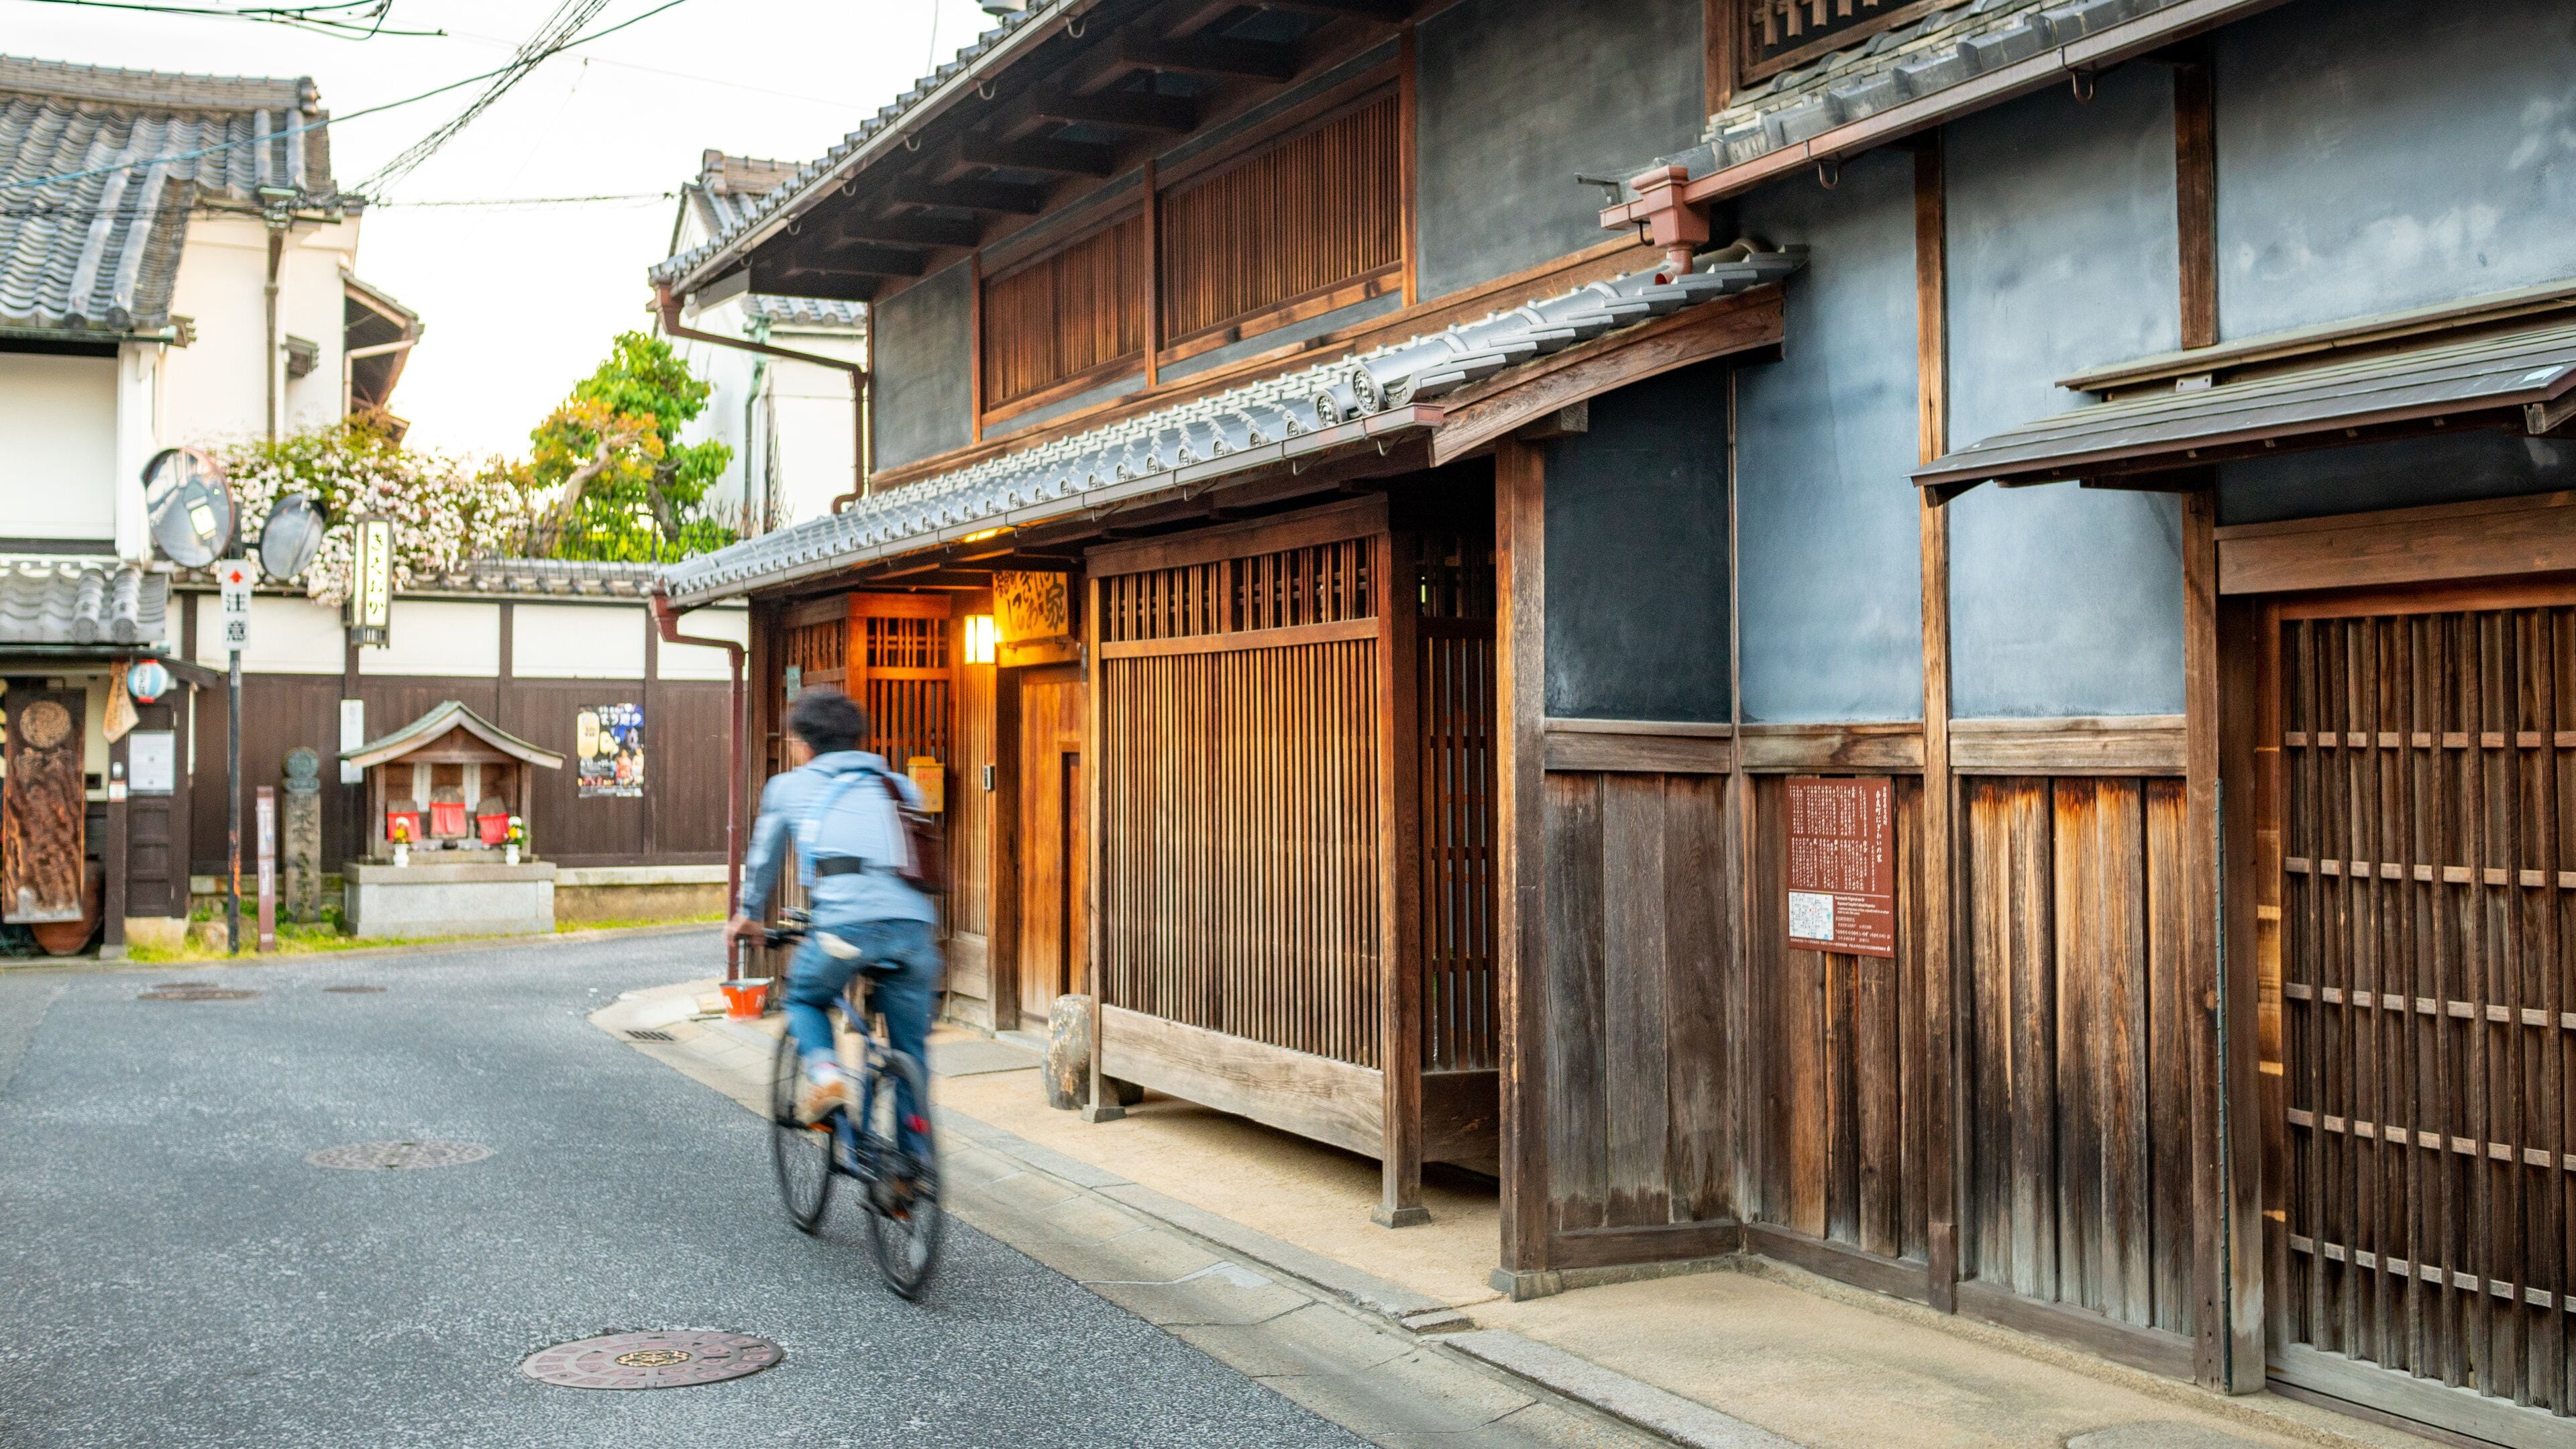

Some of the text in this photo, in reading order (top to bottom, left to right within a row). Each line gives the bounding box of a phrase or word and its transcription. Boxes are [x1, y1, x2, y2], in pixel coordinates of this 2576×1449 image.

[370, 533, 384, 615] きくおか
[226, 592, 246, 641] 注意
